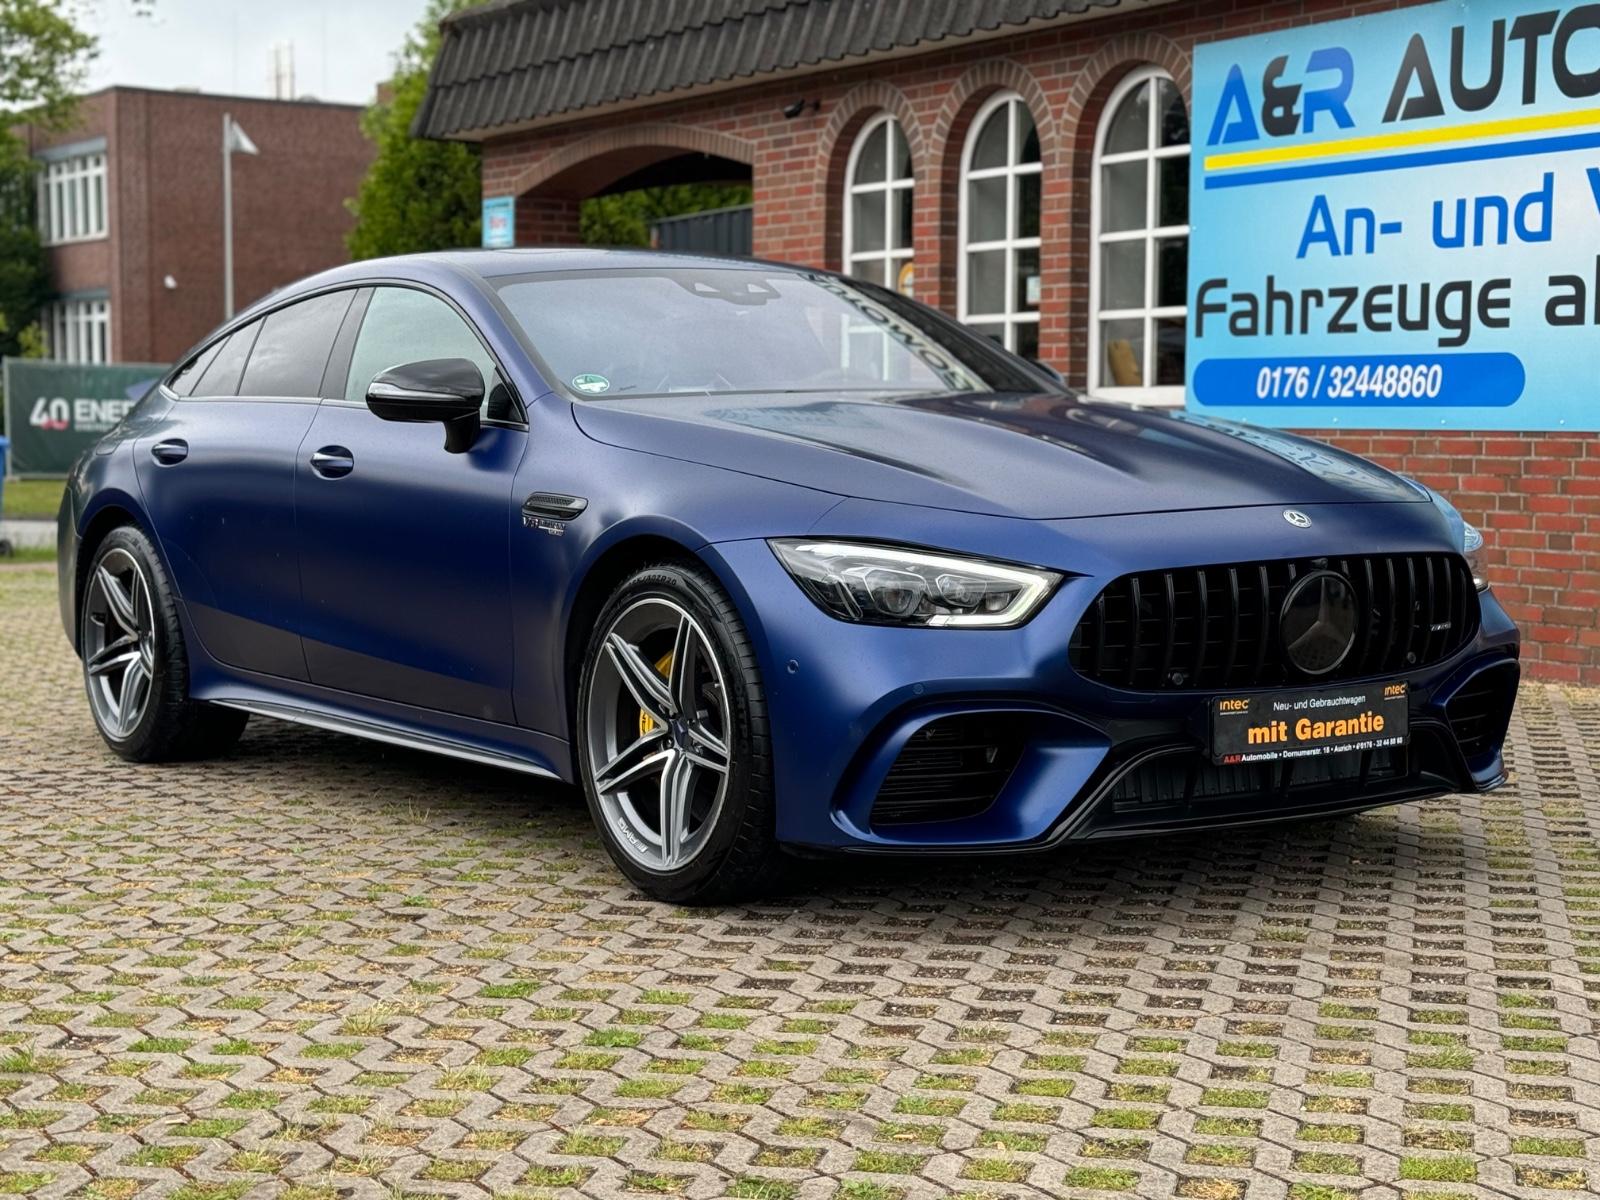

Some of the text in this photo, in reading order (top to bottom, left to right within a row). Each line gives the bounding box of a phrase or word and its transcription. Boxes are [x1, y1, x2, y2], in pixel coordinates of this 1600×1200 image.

[1207, 46, 1355, 146] A&R
[1296, 194, 1403, 259] An-
[1432, 171, 1554, 249] und
[1195, 275, 1512, 348] Fahrzeuge
[1256, 366, 1310, 400] 0176
[1328, 364, 1442, 399] 32448860
[30, 397, 70, 430] 40
[1219, 699, 1249, 711] intec
[1273, 694, 1366, 711] Neu- und Gebrauchtwagen
[1384, 684, 1407, 696] intec
[1248, 711, 1385, 744] mit Garantie
[1241, 752, 1279, 762] Automobile
